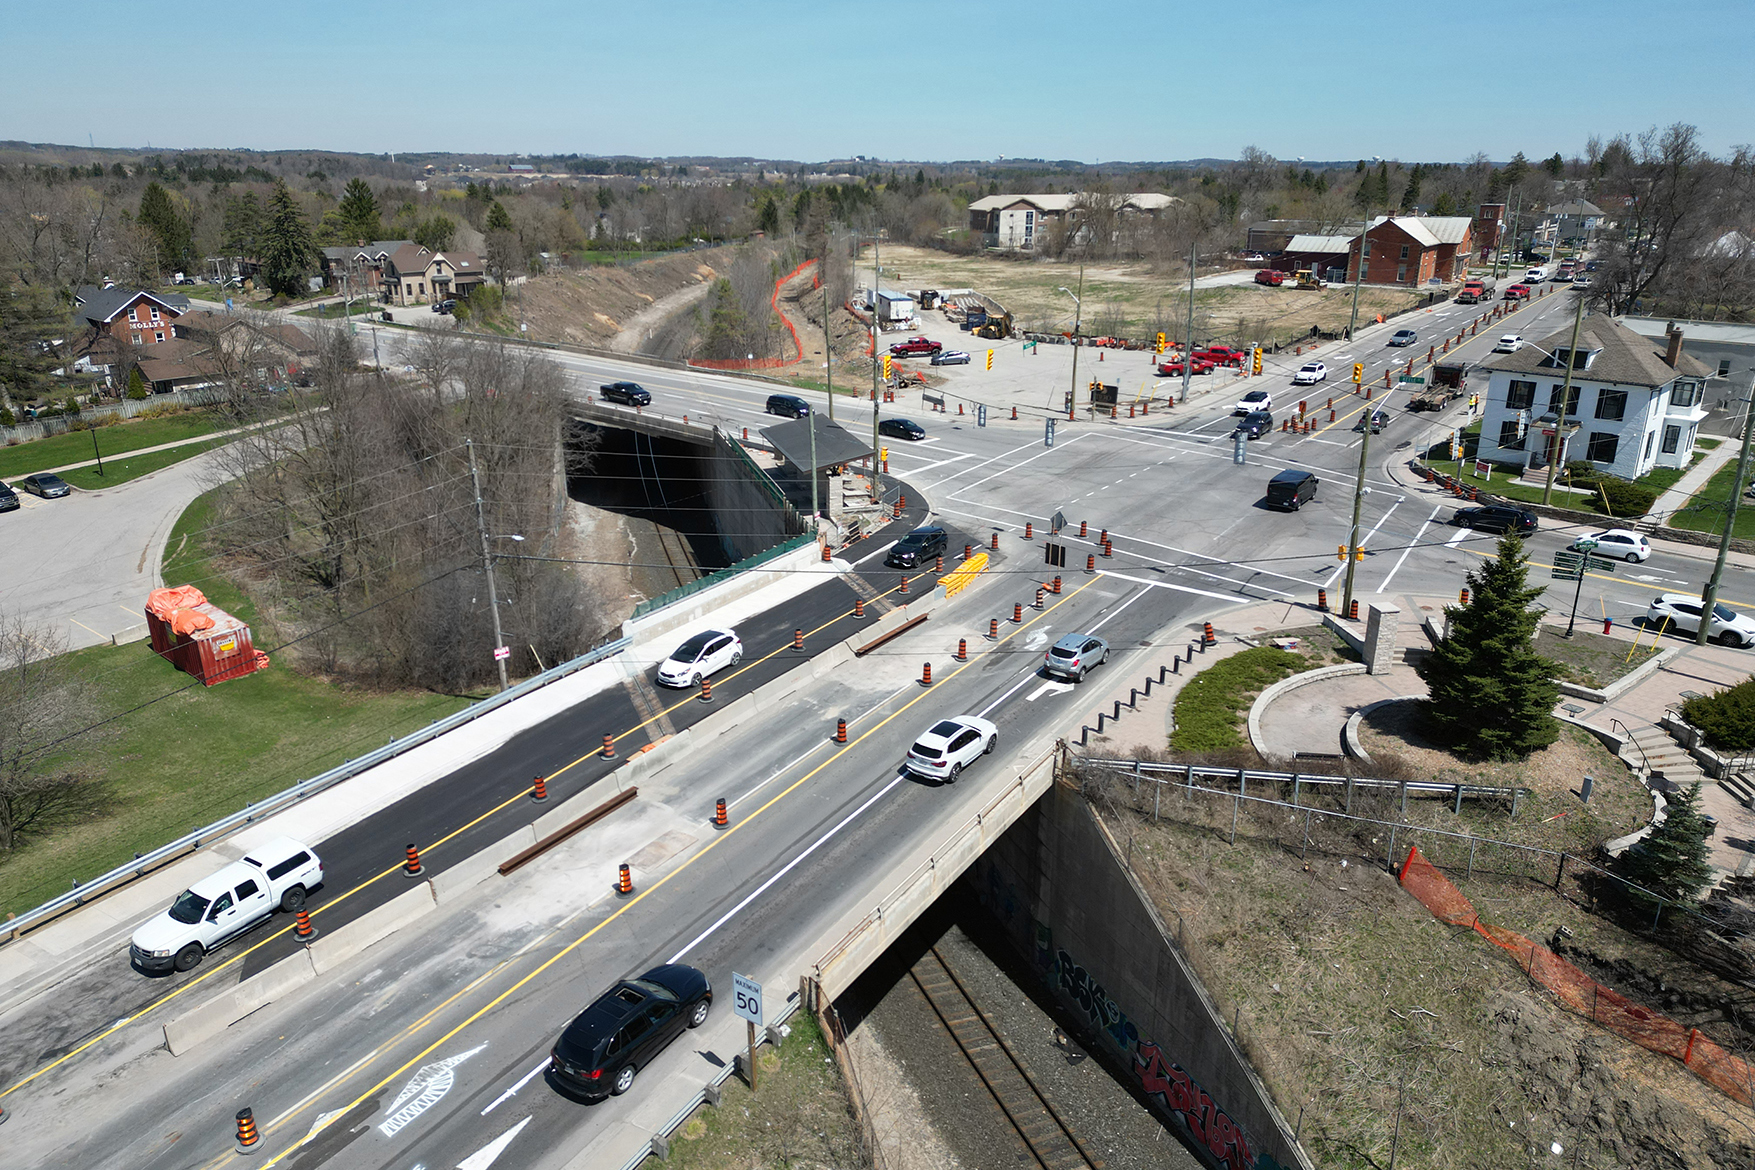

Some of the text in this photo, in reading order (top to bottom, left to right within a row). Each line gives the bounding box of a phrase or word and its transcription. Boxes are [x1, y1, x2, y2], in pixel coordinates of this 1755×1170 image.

[129, 320, 165, 330] MOLLY'S
[735, 978, 760, 995] MAXIMUM
[737, 991, 759, 1015] 50
